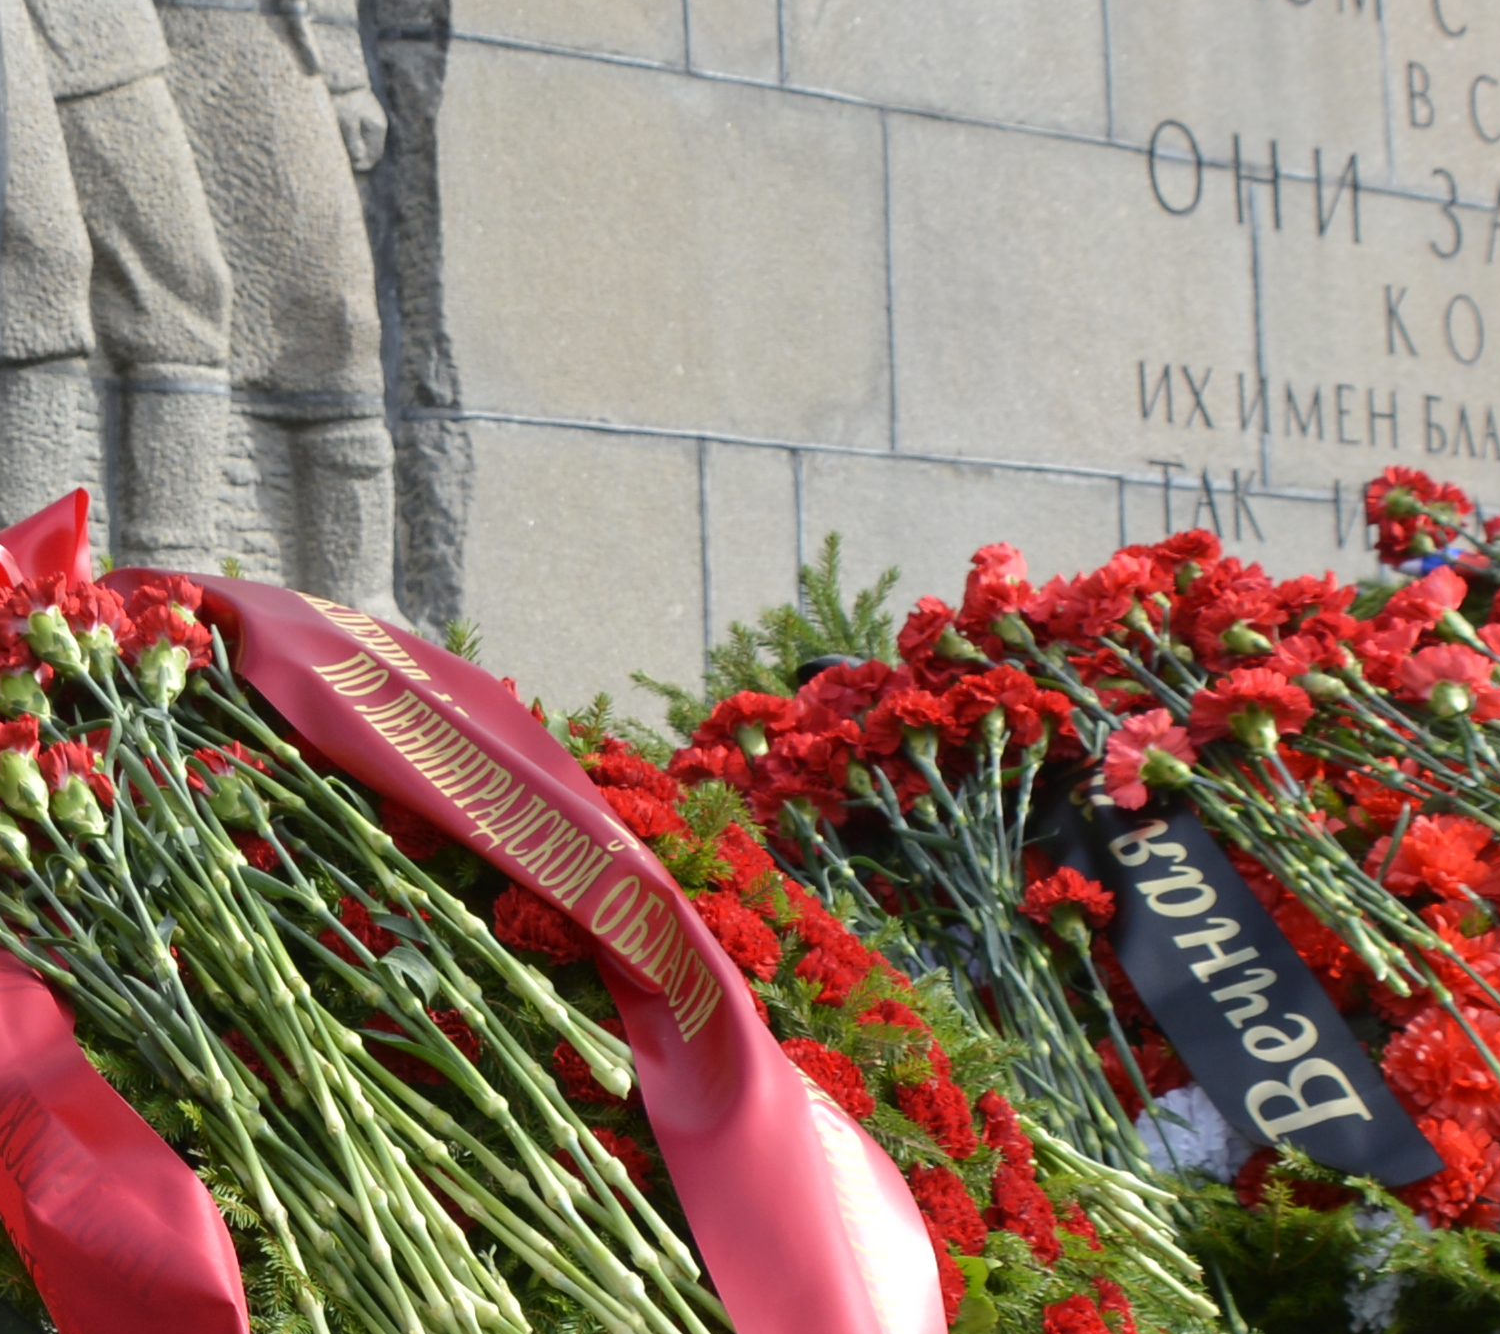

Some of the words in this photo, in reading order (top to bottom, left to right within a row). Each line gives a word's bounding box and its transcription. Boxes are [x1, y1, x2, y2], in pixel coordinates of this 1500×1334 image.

[1149, 119, 1361, 245] ОНИ
[1138, 360, 1214, 430] ИХ
[1238, 371, 1399, 450] ИМЕН
[1147, 459, 1266, 543] ТАК
[311, 650, 390, 697] ПО
[353, 689, 626, 911] ЛЕНИНГРАДСКОЙ
[590, 874, 725, 1044] ОБЛАСТИ
[1108, 817, 1375, 1144] Вечная
